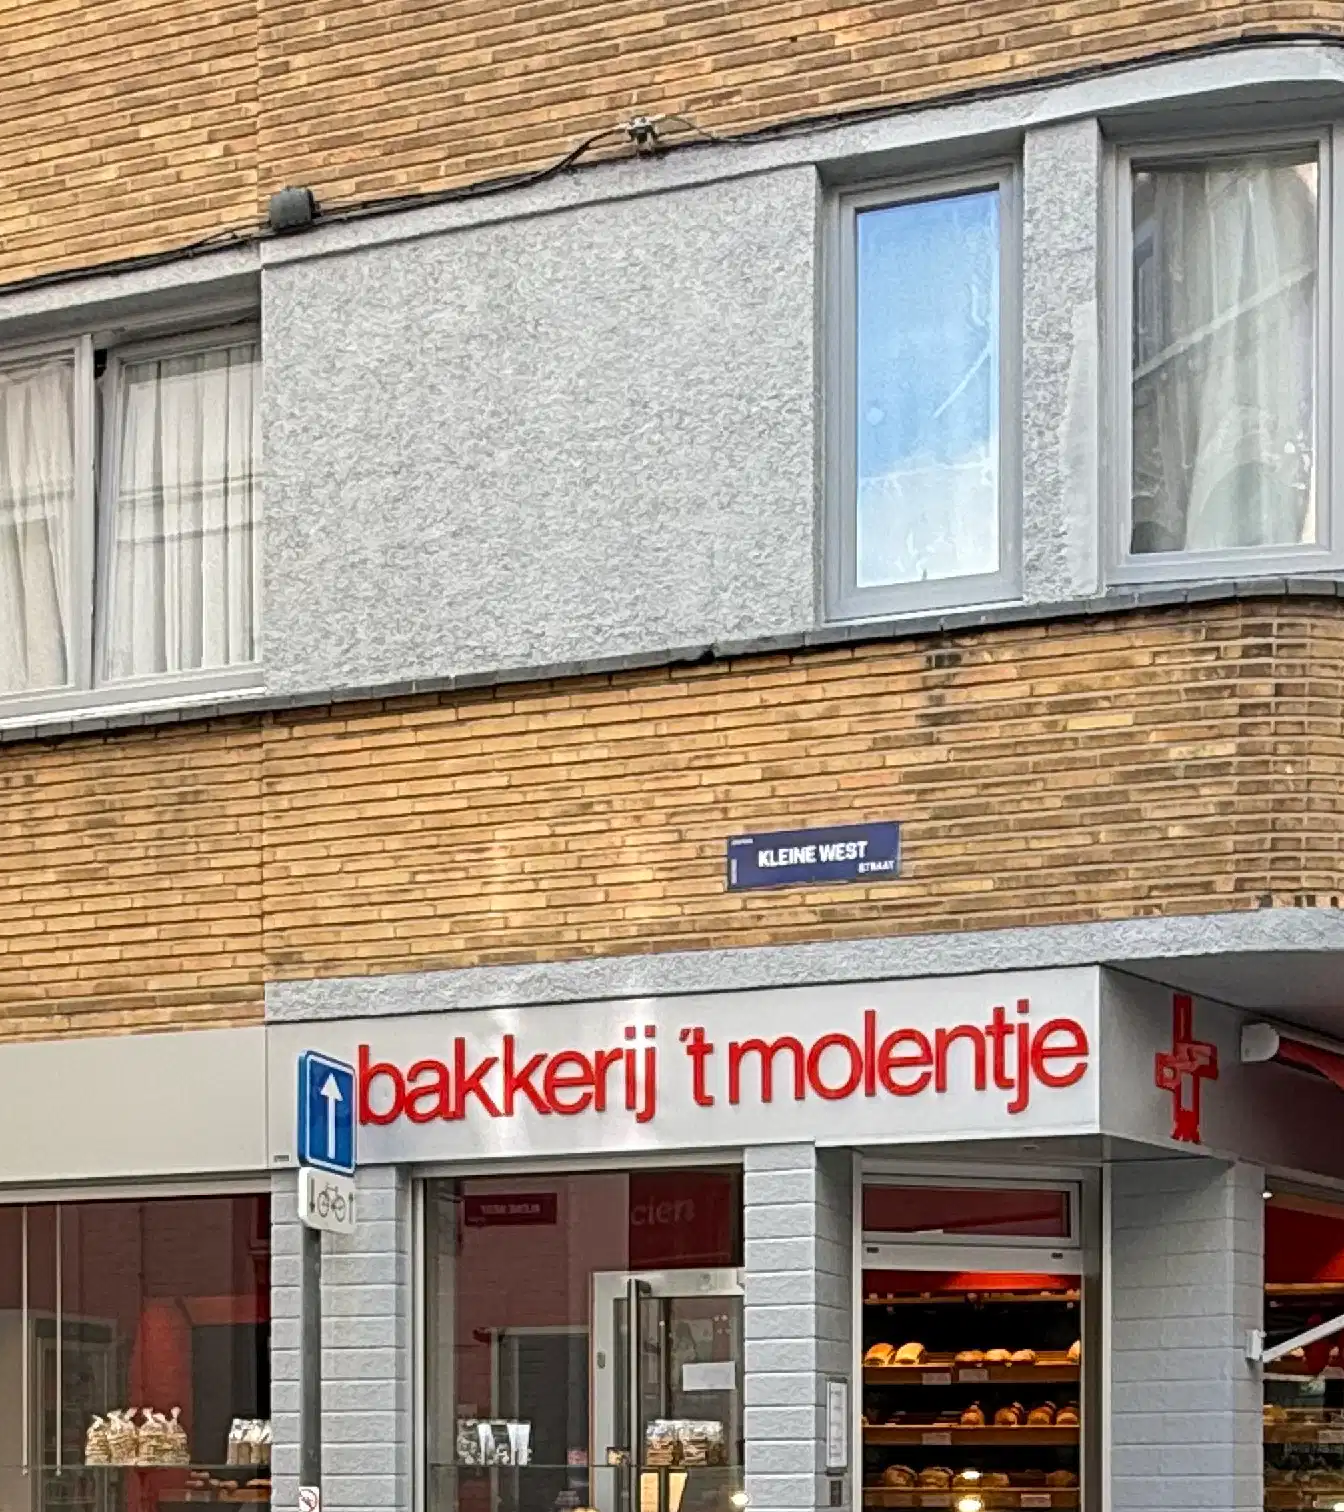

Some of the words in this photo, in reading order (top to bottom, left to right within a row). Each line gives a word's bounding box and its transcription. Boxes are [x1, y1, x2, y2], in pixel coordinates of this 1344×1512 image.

[758, 845, 817, 868] KLEINE
[818, 840, 869, 863] WEST
[358, 1025, 656, 1126] bakkerij
[728, 1000, 1090, 1114] molentje
